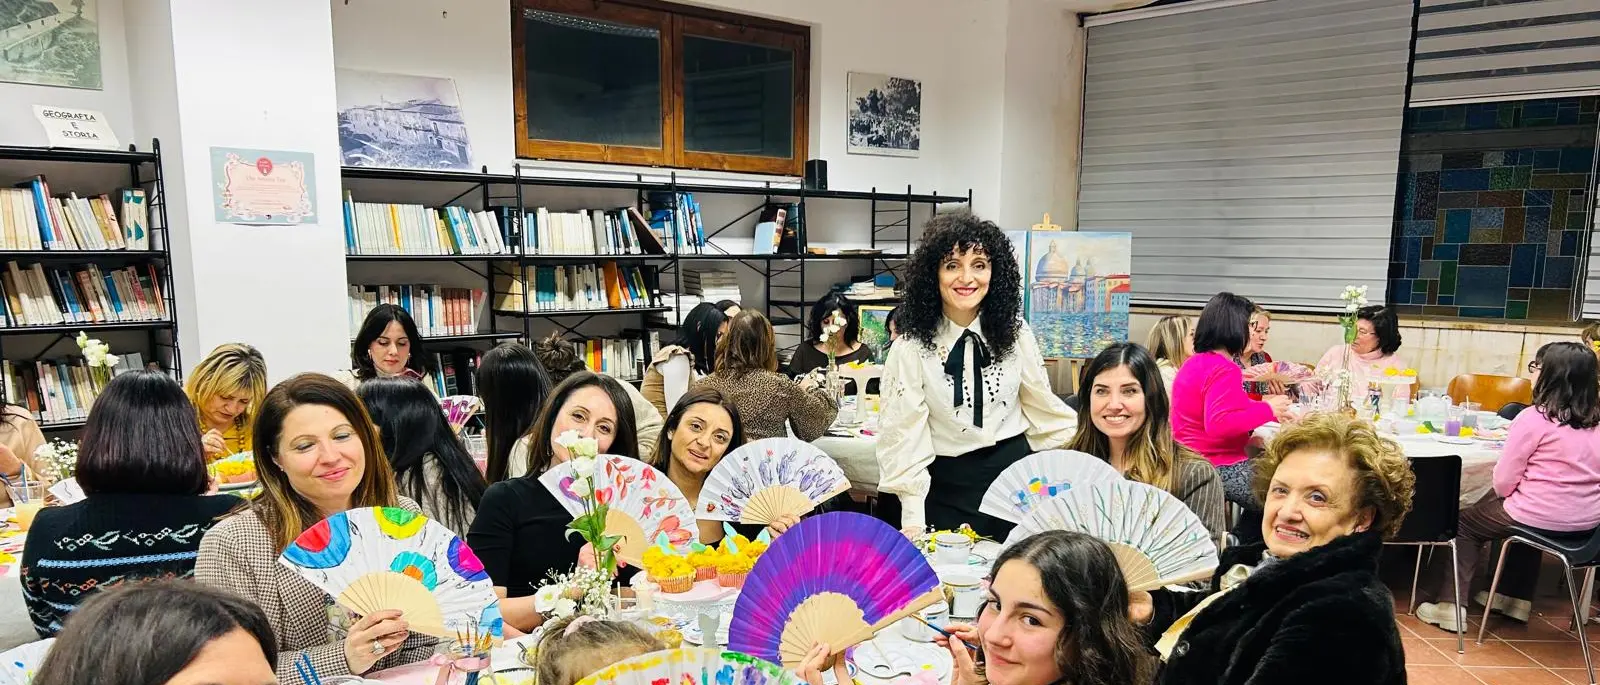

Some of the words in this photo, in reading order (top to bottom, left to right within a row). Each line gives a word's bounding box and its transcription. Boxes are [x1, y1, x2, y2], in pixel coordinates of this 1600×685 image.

[43, 110, 96, 120] GEOGRAFIA
[70, 121, 79, 129] E
[62, 130, 98, 139] STORIA
